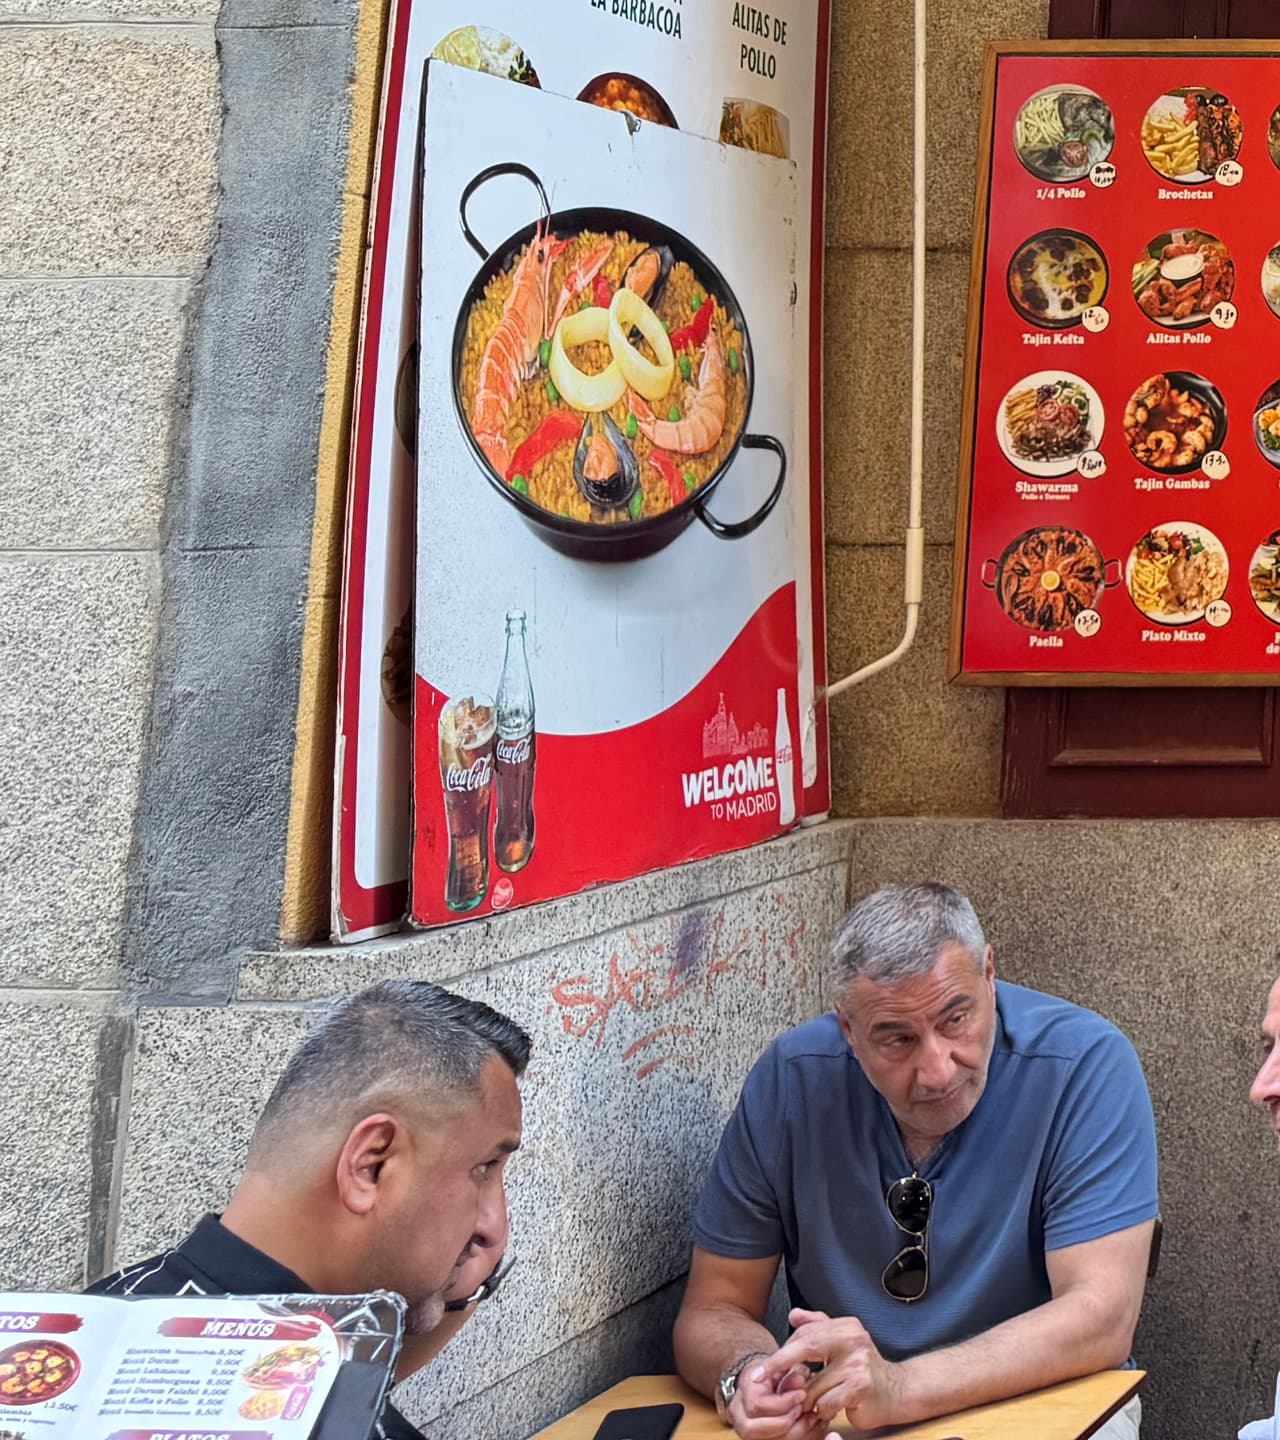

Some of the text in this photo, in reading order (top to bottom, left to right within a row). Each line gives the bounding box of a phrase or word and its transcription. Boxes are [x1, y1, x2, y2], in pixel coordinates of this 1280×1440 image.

[732, 2, 787, 46] ALITAS DE
[740, 44, 777, 79] POLLO
[1036, 187, 1086, 199] 1/4 Pollo
[1158, 188, 1213, 200] Brochetas
[1022, 333, 1085, 345] Tajin Kefta
[1147, 332, 1211, 344] Alitas Pollo
[1015, 481, 1078, 493] Shawarma
[1134, 478, 1210, 490] Tajin Gambas
[1029, 636, 1064, 647] Paella
[1142, 629, 1206, 642] Plato Mixto
[1266, 643, 1279, 654] de
[682, 756, 774, 809] WELCOME
[711, 791, 777, 822] TO MADRID
